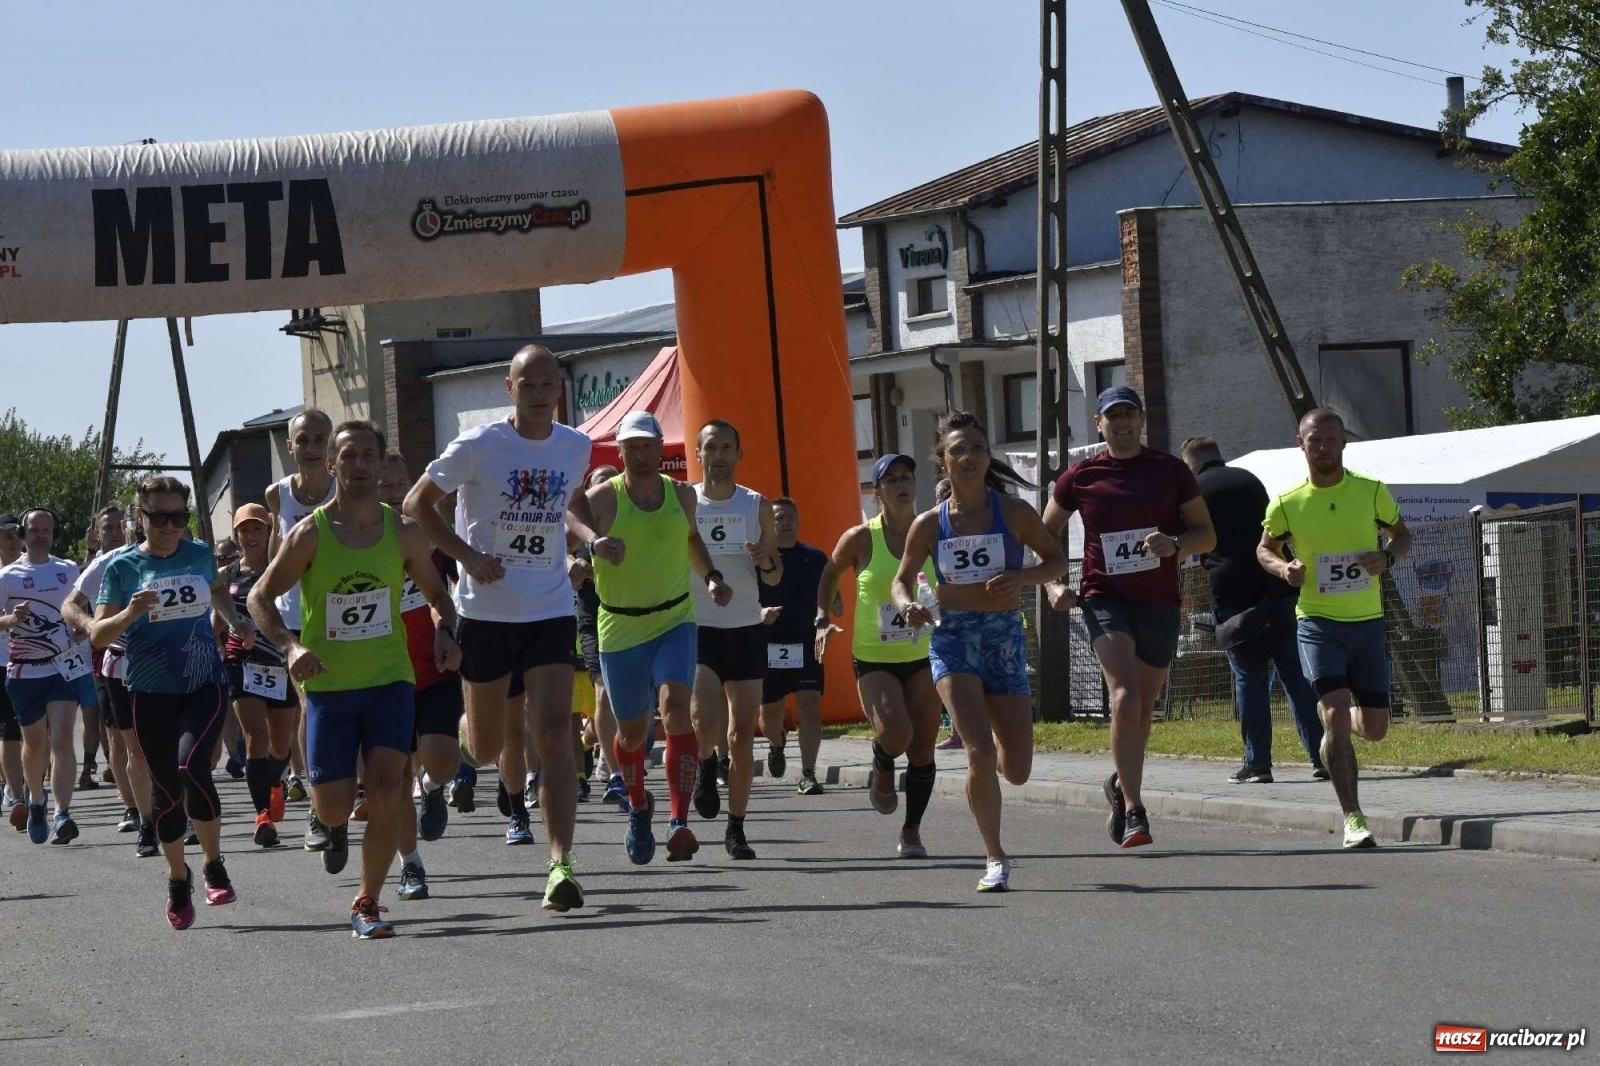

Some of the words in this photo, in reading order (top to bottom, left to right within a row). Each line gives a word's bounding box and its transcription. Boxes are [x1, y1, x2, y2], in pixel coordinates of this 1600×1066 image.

[444, 193, 511, 207] Elektroniczny
[515, 190, 548, 203] pomiar
[551, 188, 579, 198] czasu
[443, 204, 586, 232] ZmierzymyCzas.pl
[92, 178, 346, 287] META
[658, 457, 687, 471] mie
[1397, 495, 1423, 504] Gmina
[1425, 495, 1470, 504] Krzanowice
[1402, 514, 1422, 523] Obec
[501, 523, 537, 533] COLOUR
[711, 525, 726, 542] 6
[509, 534, 546, 555] 48
[942, 539, 977, 550] COLOUR
[1115, 541, 1148, 560] 44
[953, 547, 991, 570] 36
[1330, 562, 1361, 581] 56
[401, 576, 421, 598] 2
[160, 585, 197, 608] 28
[331, 595, 367, 605] COLOUR
[341, 603, 378, 626] 67
[891, 612, 907, 628] 4
[64, 653, 85, 671] 21
[779, 648, 789, 660] 2
[253, 673, 276, 689] 35
